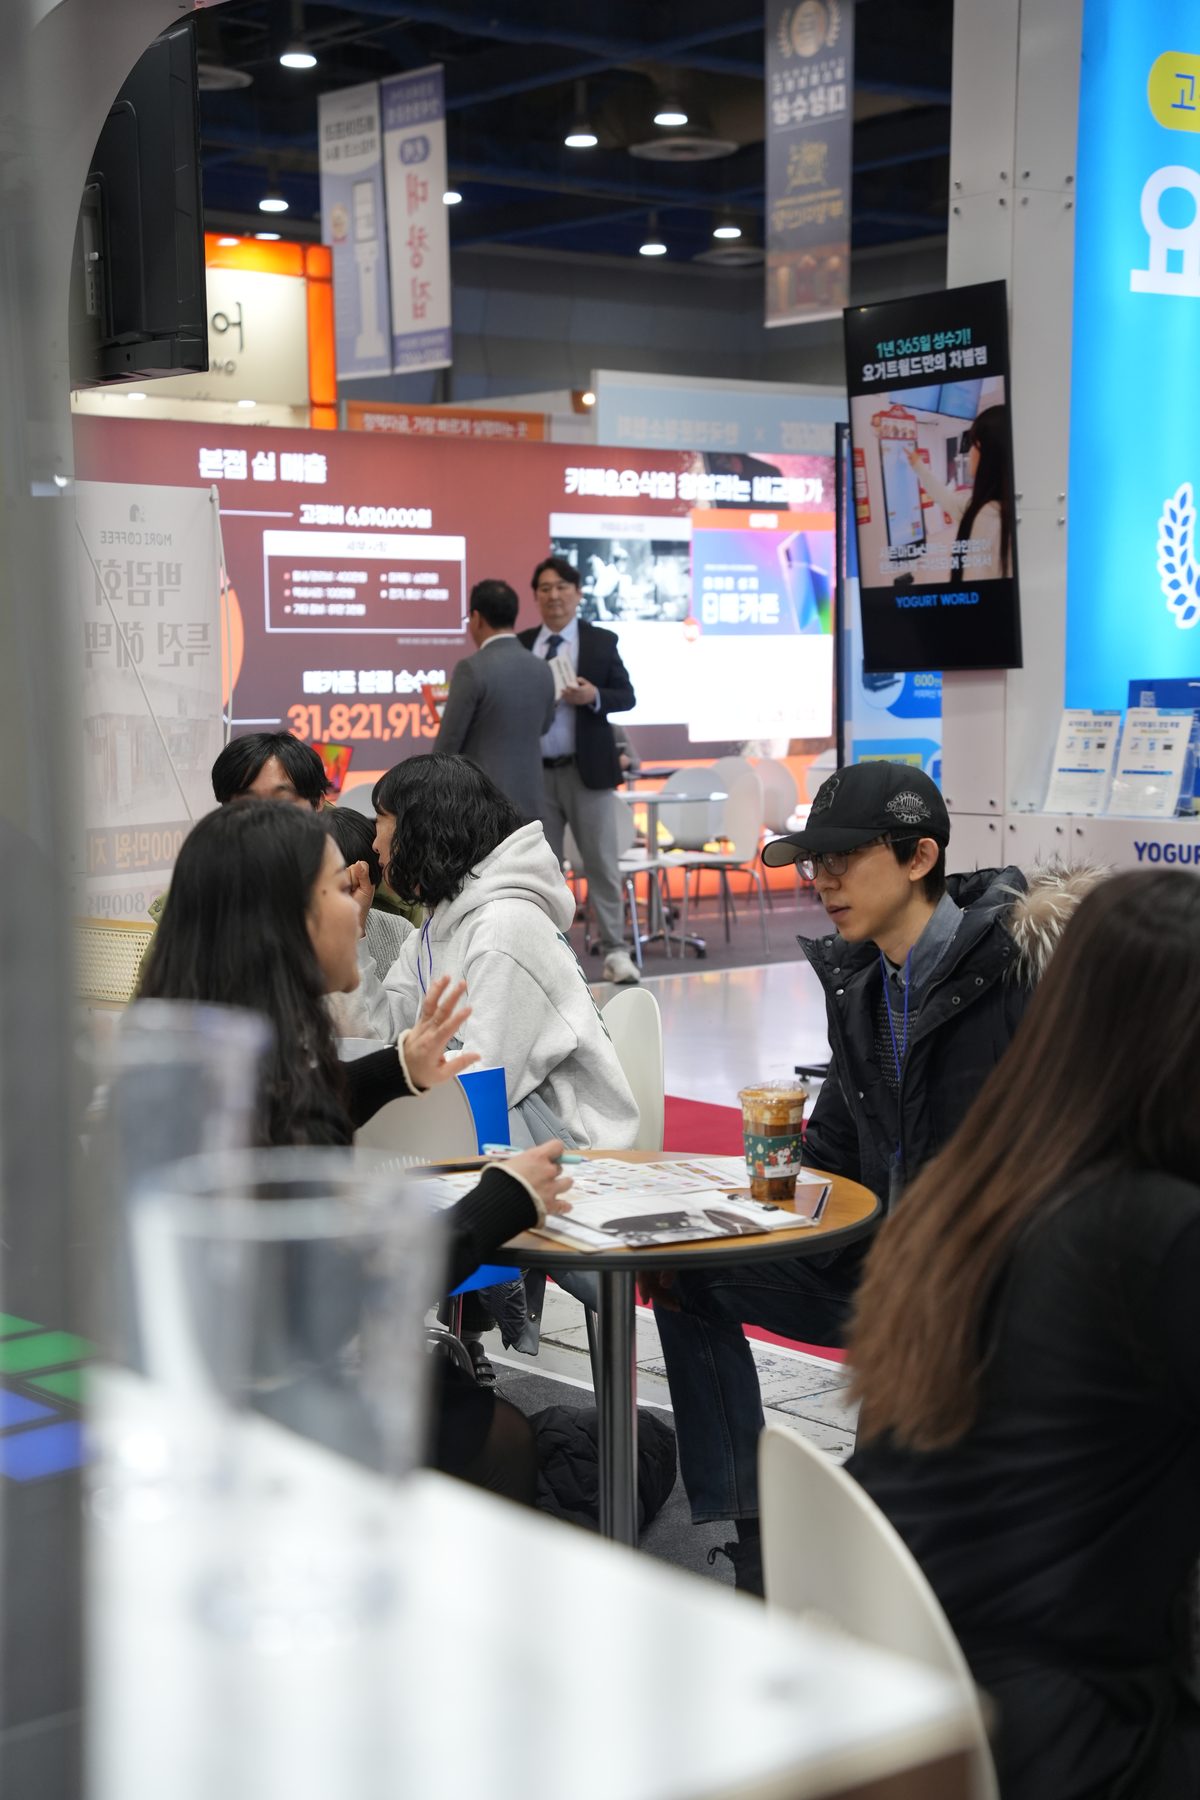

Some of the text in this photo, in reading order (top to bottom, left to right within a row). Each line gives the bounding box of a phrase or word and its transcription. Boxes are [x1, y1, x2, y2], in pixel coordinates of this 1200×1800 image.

[1130, 165, 1200, 297] 요
[876, 328, 971, 359] 1년 365일 성수기!
[862, 345, 988, 382] 요거트월드만의 차별점
[198, 447, 327, 484] 본점 실 매출
[896, 591, 979, 609] YOGURT WORLD
